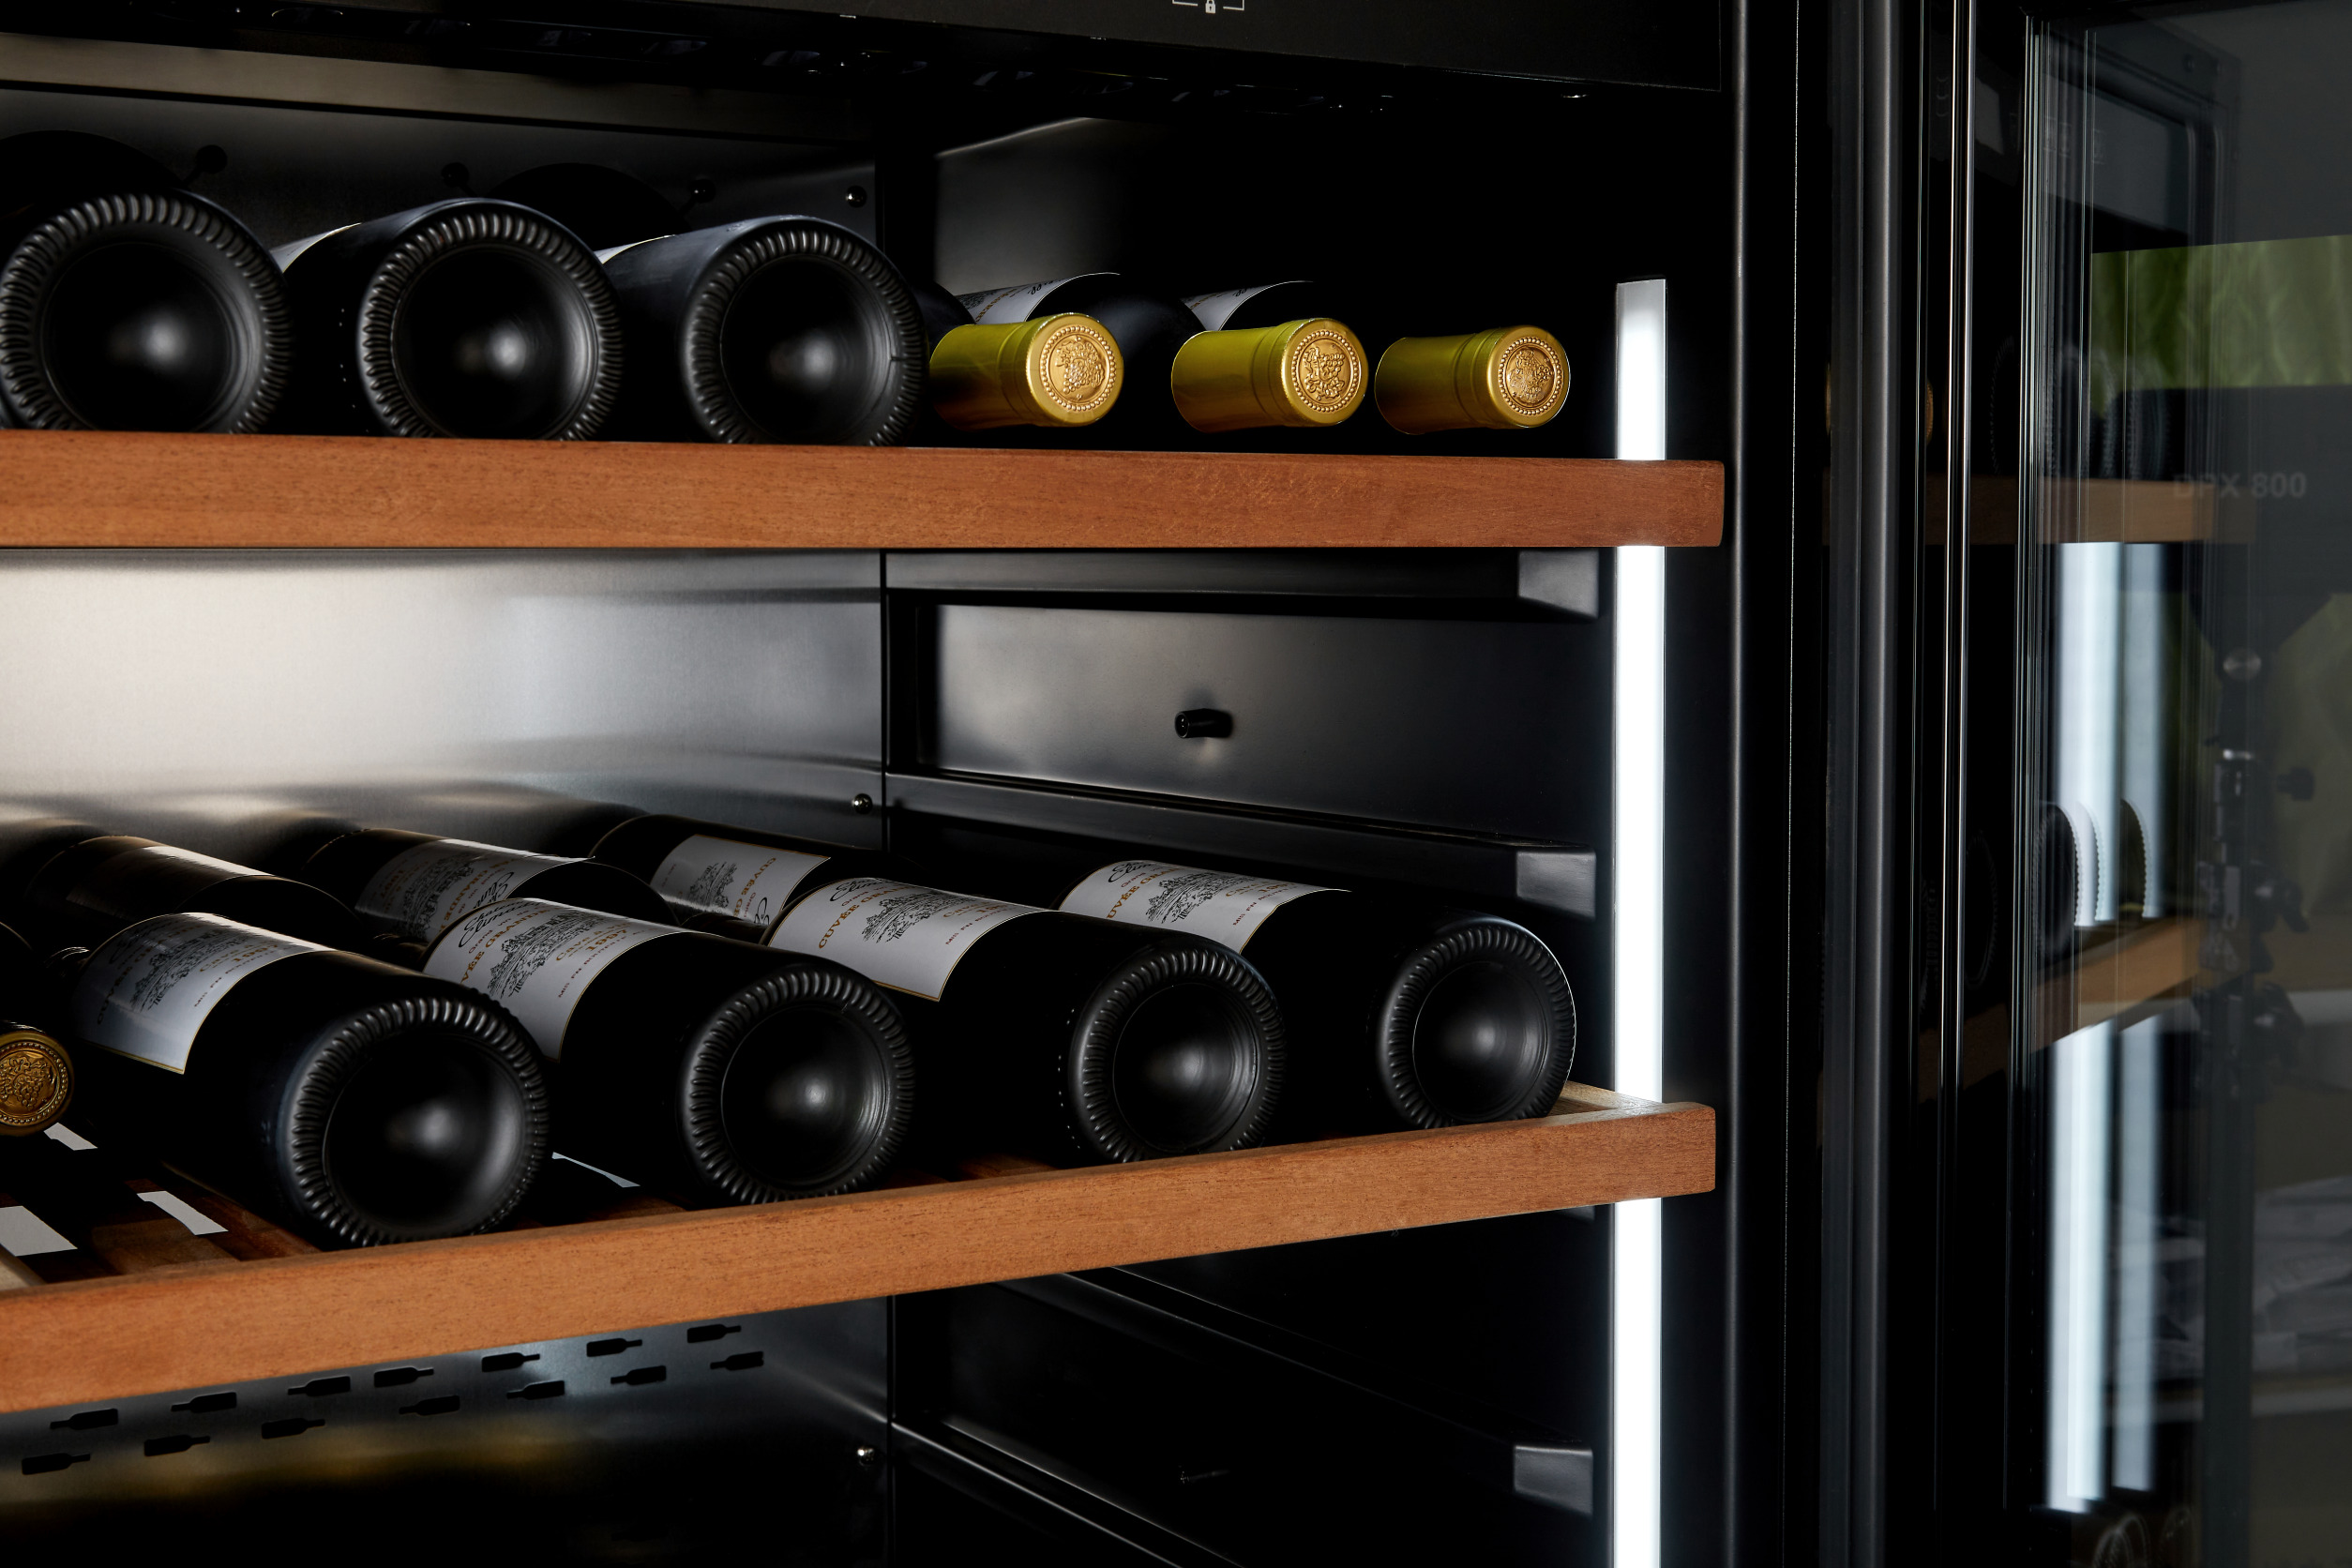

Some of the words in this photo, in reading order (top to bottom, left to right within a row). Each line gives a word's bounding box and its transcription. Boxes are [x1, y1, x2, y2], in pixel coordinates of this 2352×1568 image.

[2252, 471, 2307, 498] 800
[1107, 885, 1140, 918] UVÉE
[584, 928, 627, 951] 1997
[819, 904, 860, 949] CUVÉE
[469, 929, 493, 954] Grand
[556, 937, 591, 961] Cave
[460, 950, 485, 985] VÉE
